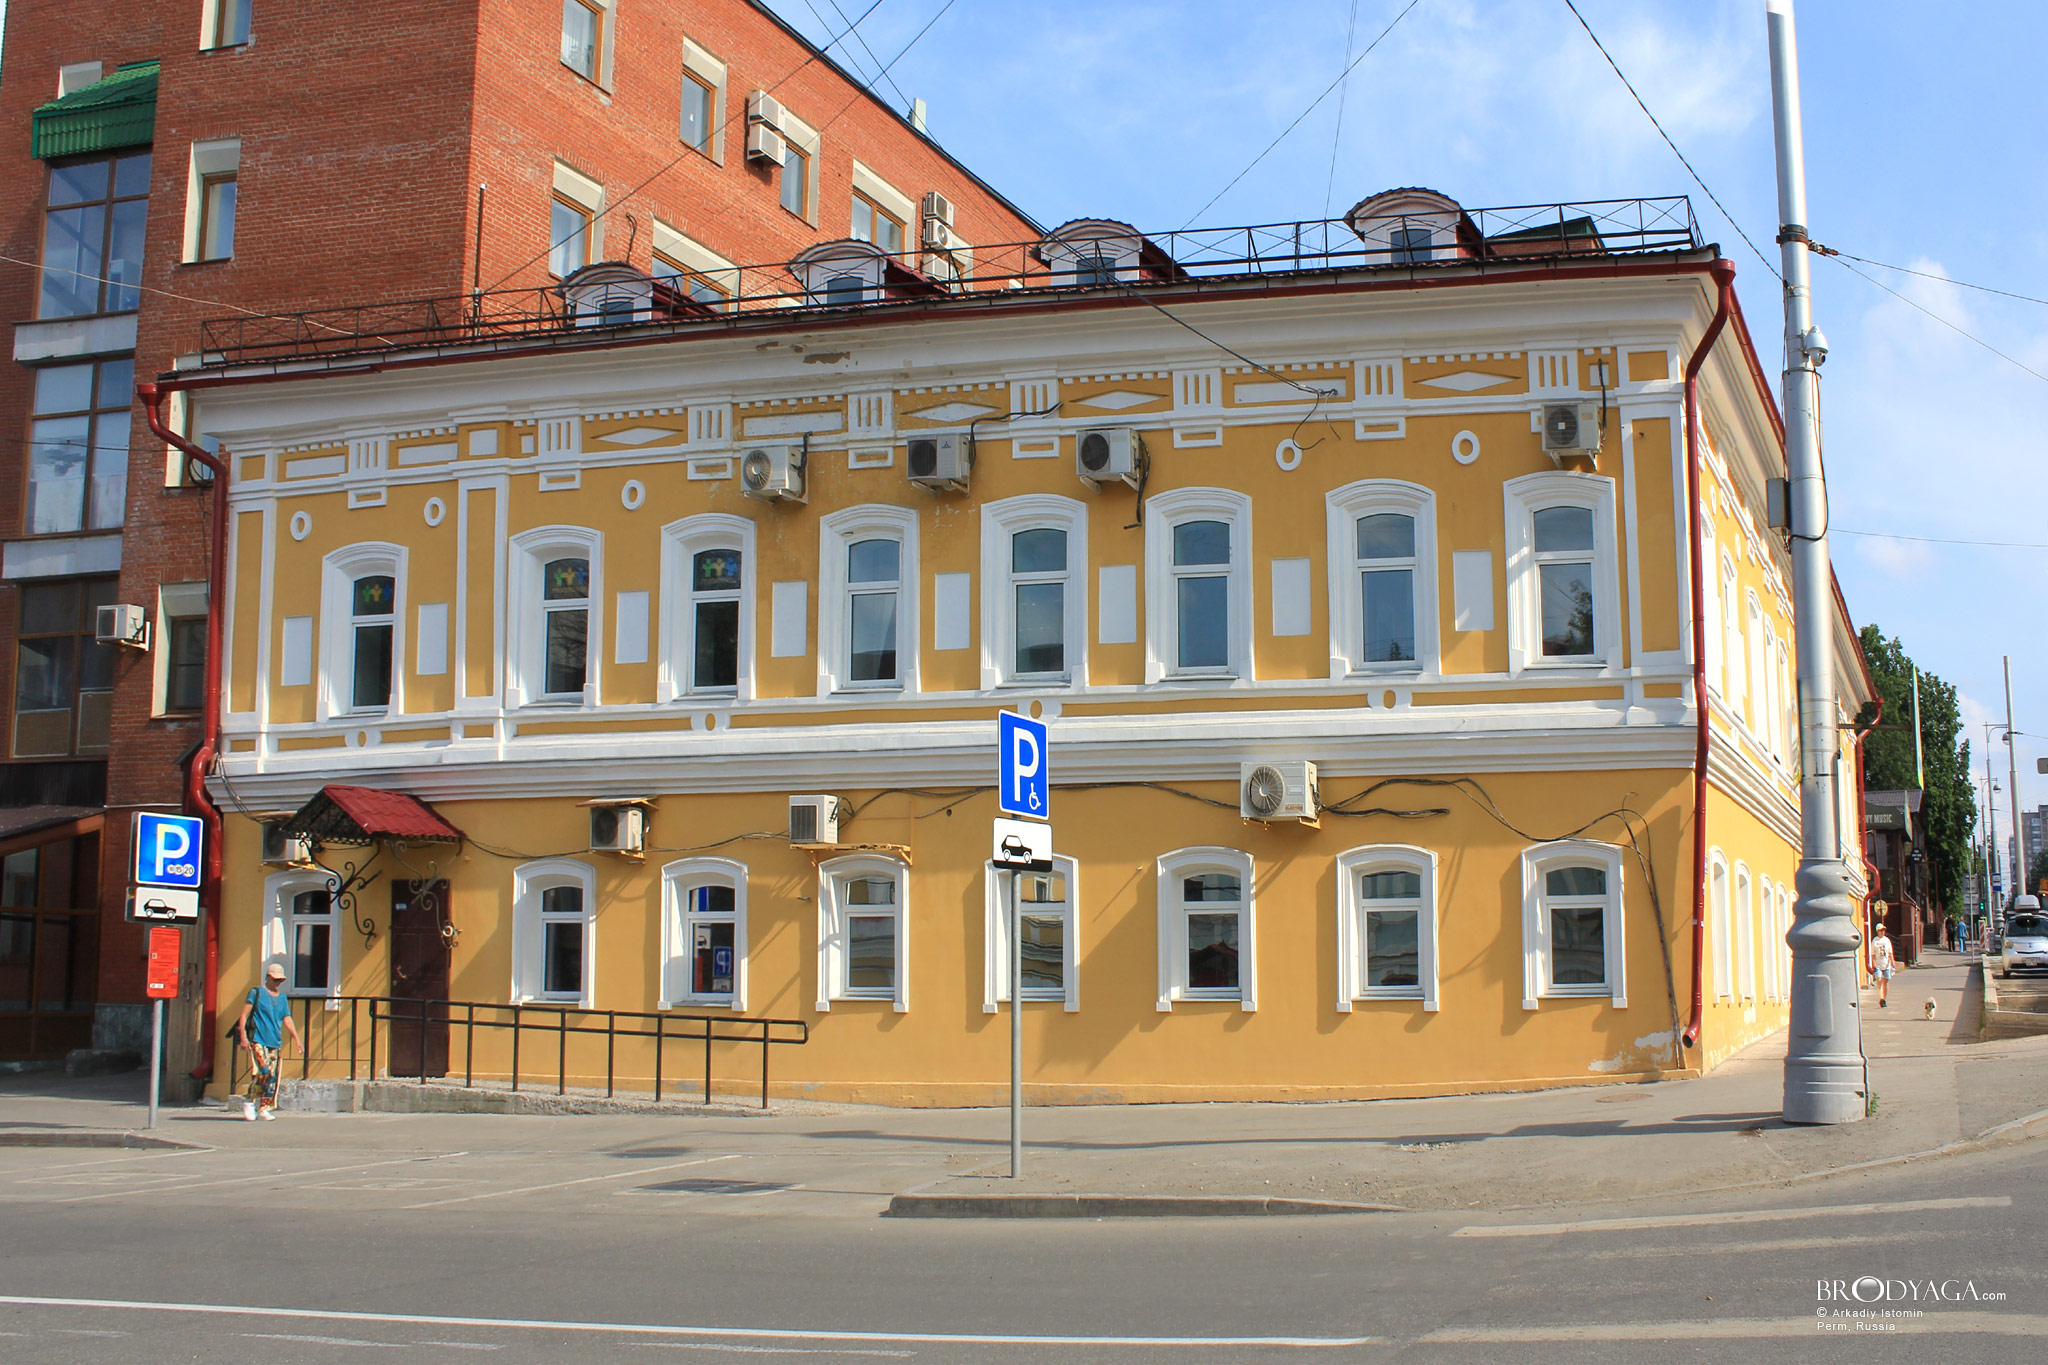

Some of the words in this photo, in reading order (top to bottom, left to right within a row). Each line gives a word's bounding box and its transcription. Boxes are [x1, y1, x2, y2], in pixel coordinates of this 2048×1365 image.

[1013, 727, 1039, 802] P
[1874, 814, 1892, 823] MUSIC
[155, 823, 190, 876] P
[184, 866, 194, 875] 20
